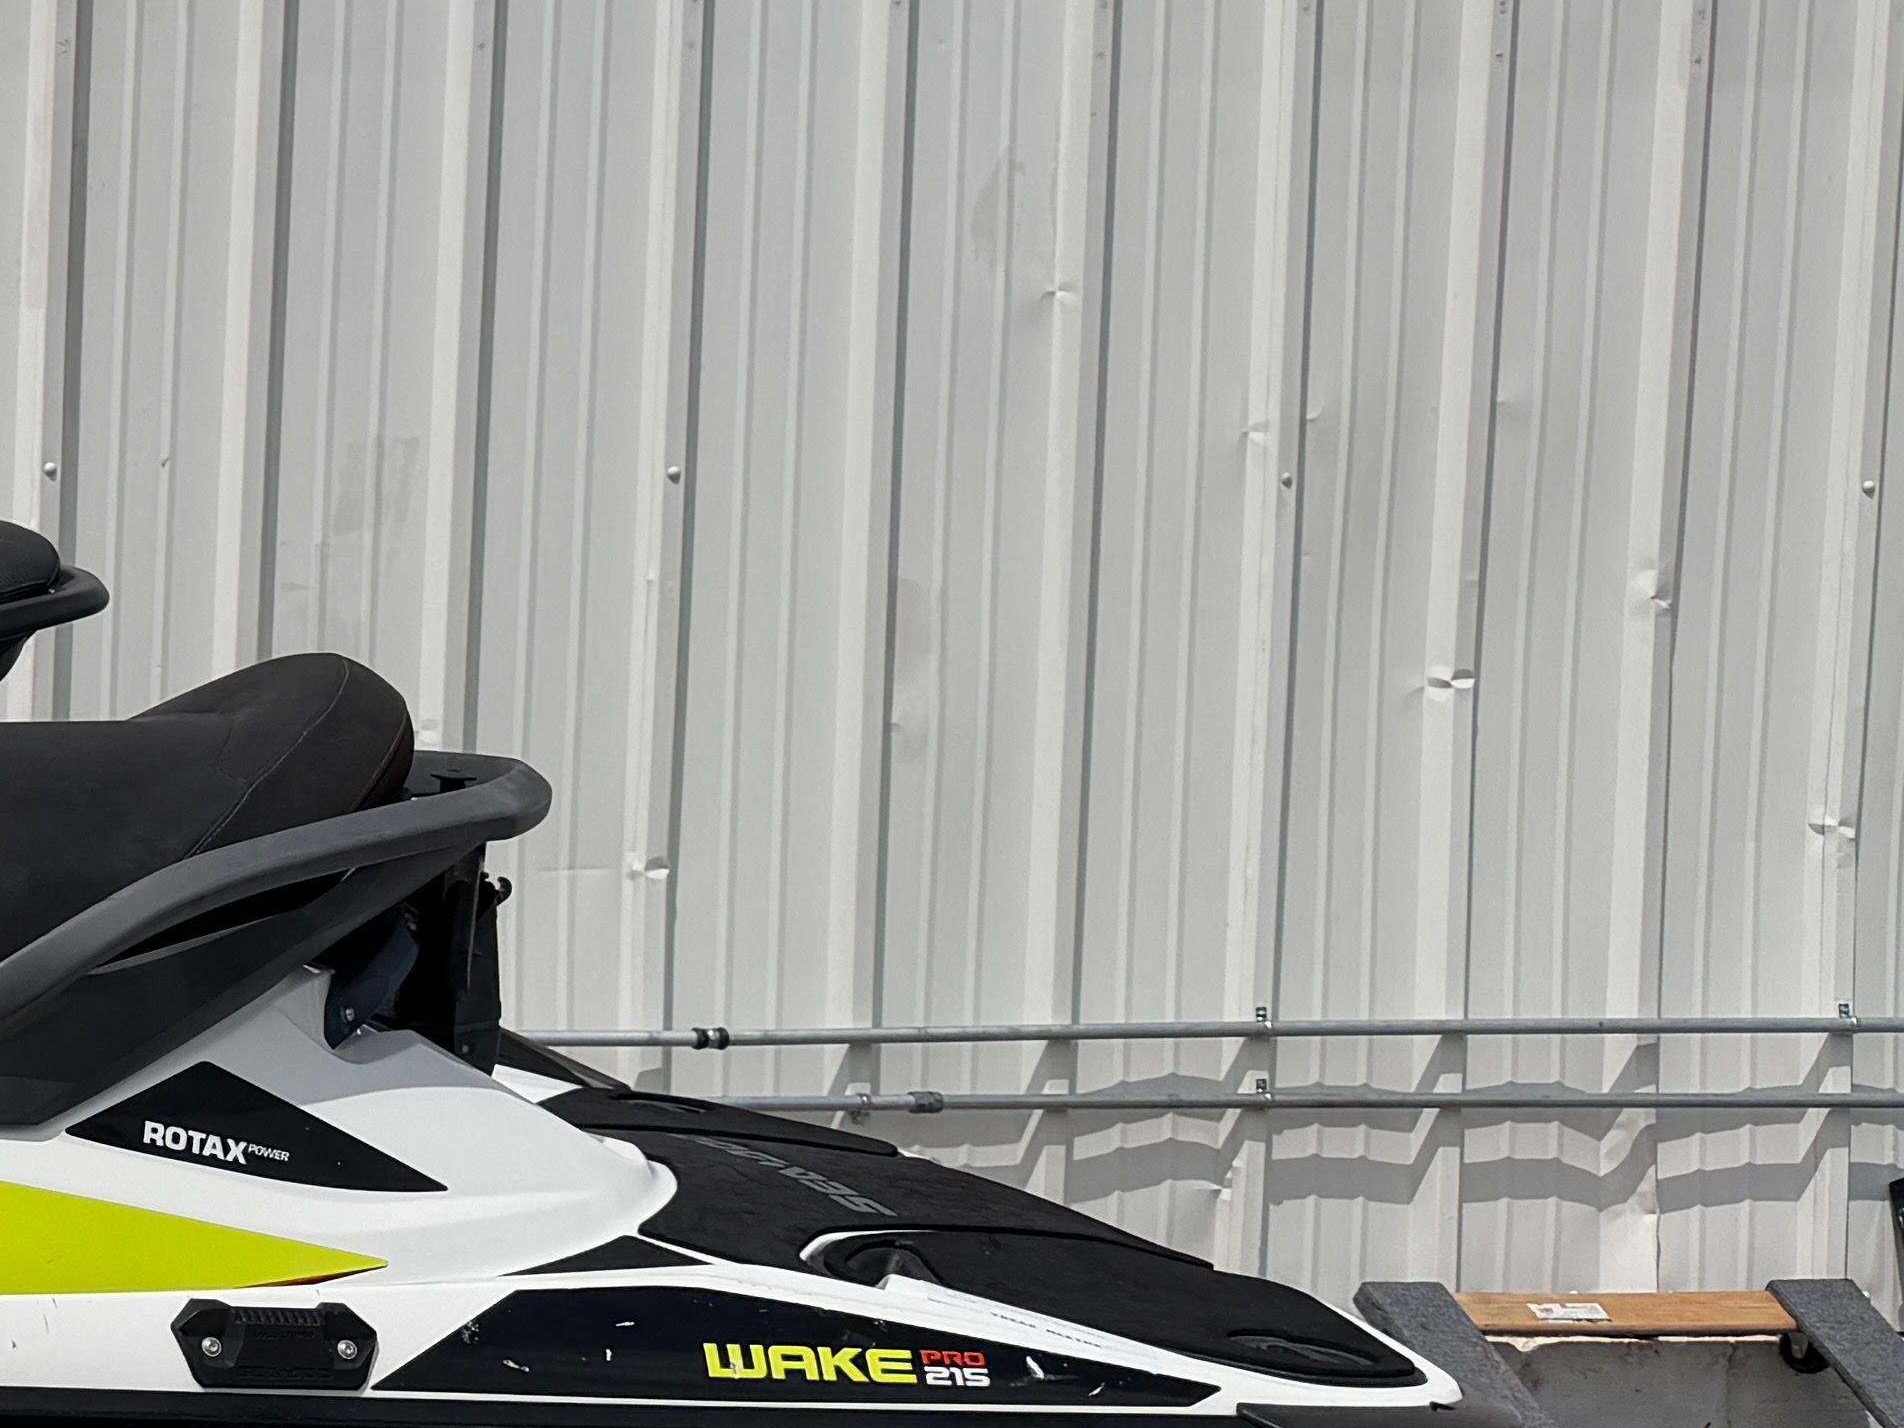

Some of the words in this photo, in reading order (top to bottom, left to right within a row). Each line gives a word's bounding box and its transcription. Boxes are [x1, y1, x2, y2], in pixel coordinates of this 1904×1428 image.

[142, 1120, 247, 1165] ROTAX
[247, 1143, 290, 1162] POWER
[703, 1343, 918, 1384] WAKE
[920, 1350, 985, 1367] PRO
[926, 1366, 991, 1387] 215
